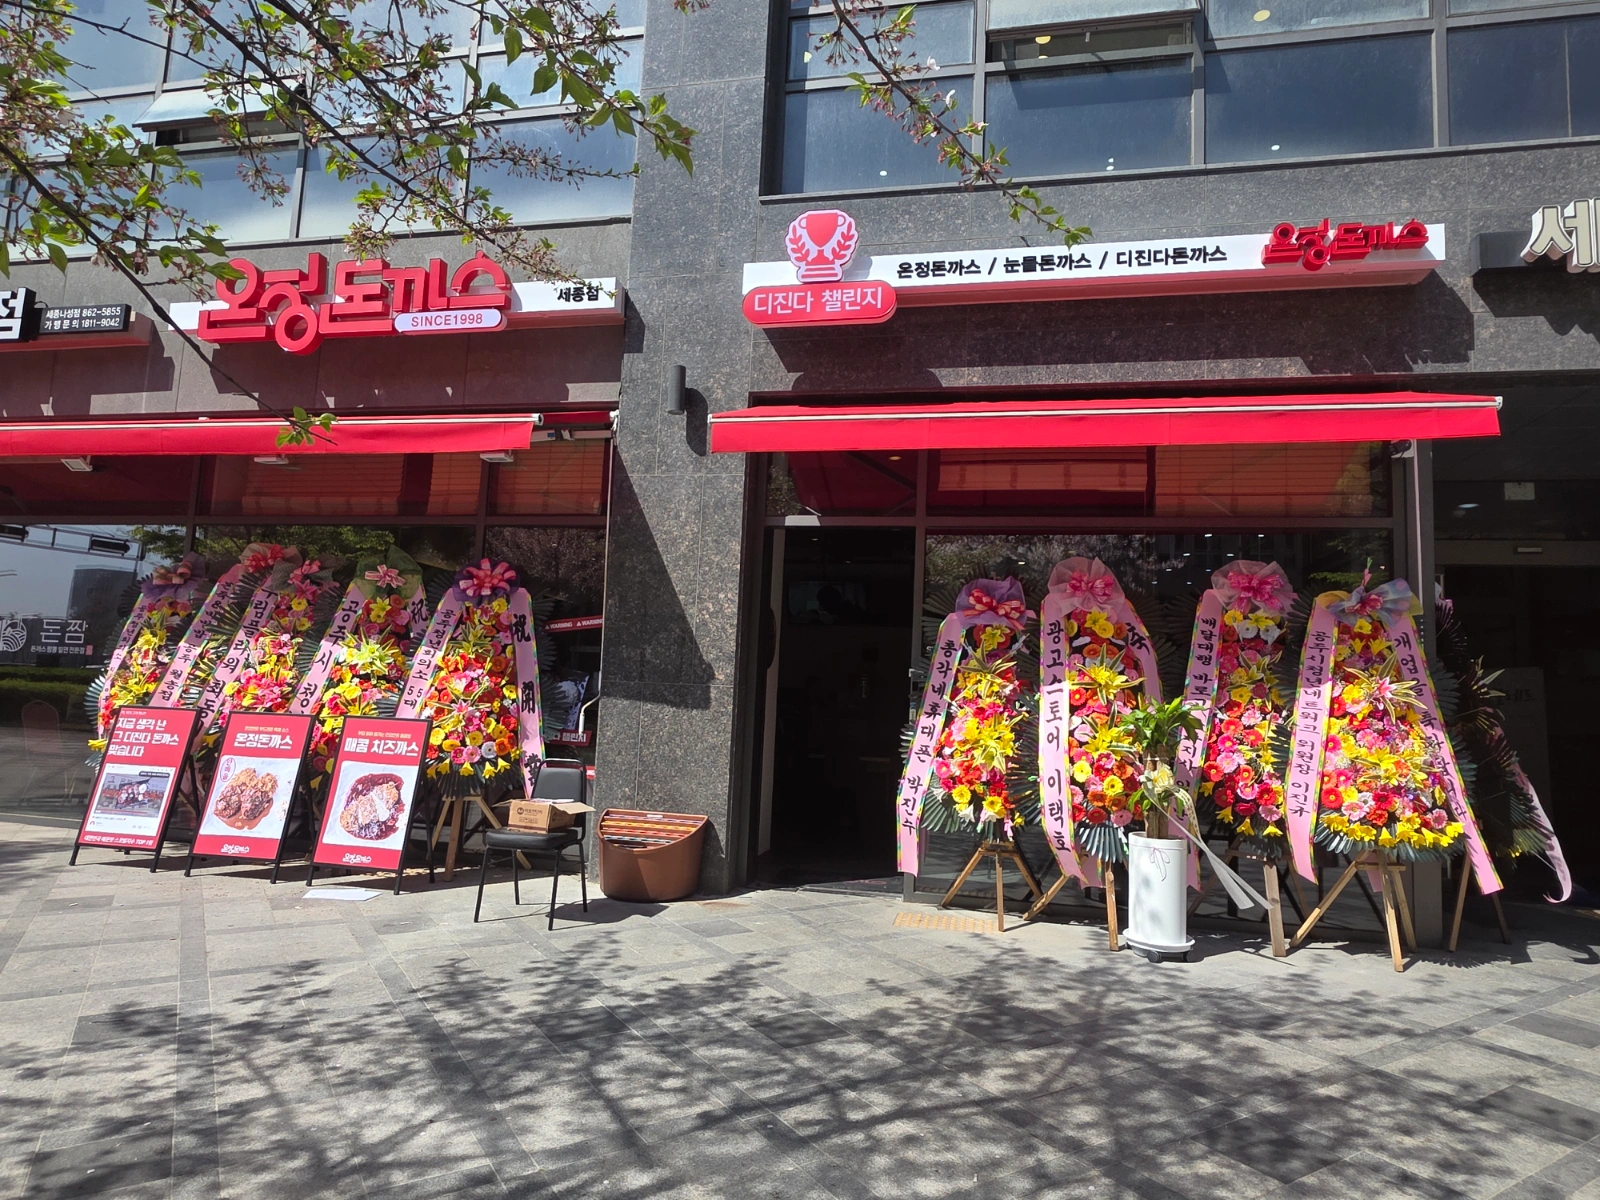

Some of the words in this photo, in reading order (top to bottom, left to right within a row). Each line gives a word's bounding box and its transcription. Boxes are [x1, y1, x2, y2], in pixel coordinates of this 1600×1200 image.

[897, 261, 982, 279] 온정돈까스
[1003, 253, 1092, 274] 눈물돈까스
[1116, 245, 1228, 268] 디진다돈까스
[198, 251, 511, 355] 온정돈까스
[556, 285, 600, 303] 세종점
[754, 290, 813, 314] 디진다
[821, 286, 883, 313] 챌린지
[82, 306, 121, 317] 862-5855
[411, 312, 484, 328] SINCE1998
[81, 318, 120, 328] 1811-9042
[1125, 622, 1151, 655] 축
[1194, 617, 1218, 667] 배달대행
[1045, 619, 1065, 752] 광고스토어
[116, 717, 136, 729] 지금
[136, 718, 155, 730] 생각
[155, 719, 167, 730] 난
[111, 730, 123, 742] 그
[123, 731, 151, 743] 디진다
[151, 733, 179, 745] 돈까스
[233, 732, 293, 750] 온정돈까스
[344, 737, 369, 753] 매콤
[371, 739, 419, 757] 치즈까스
[107, 744, 144, 757] 맞습니다
[901, 775, 923, 836] 박진수
[1047, 768, 1072, 852] 이택호
